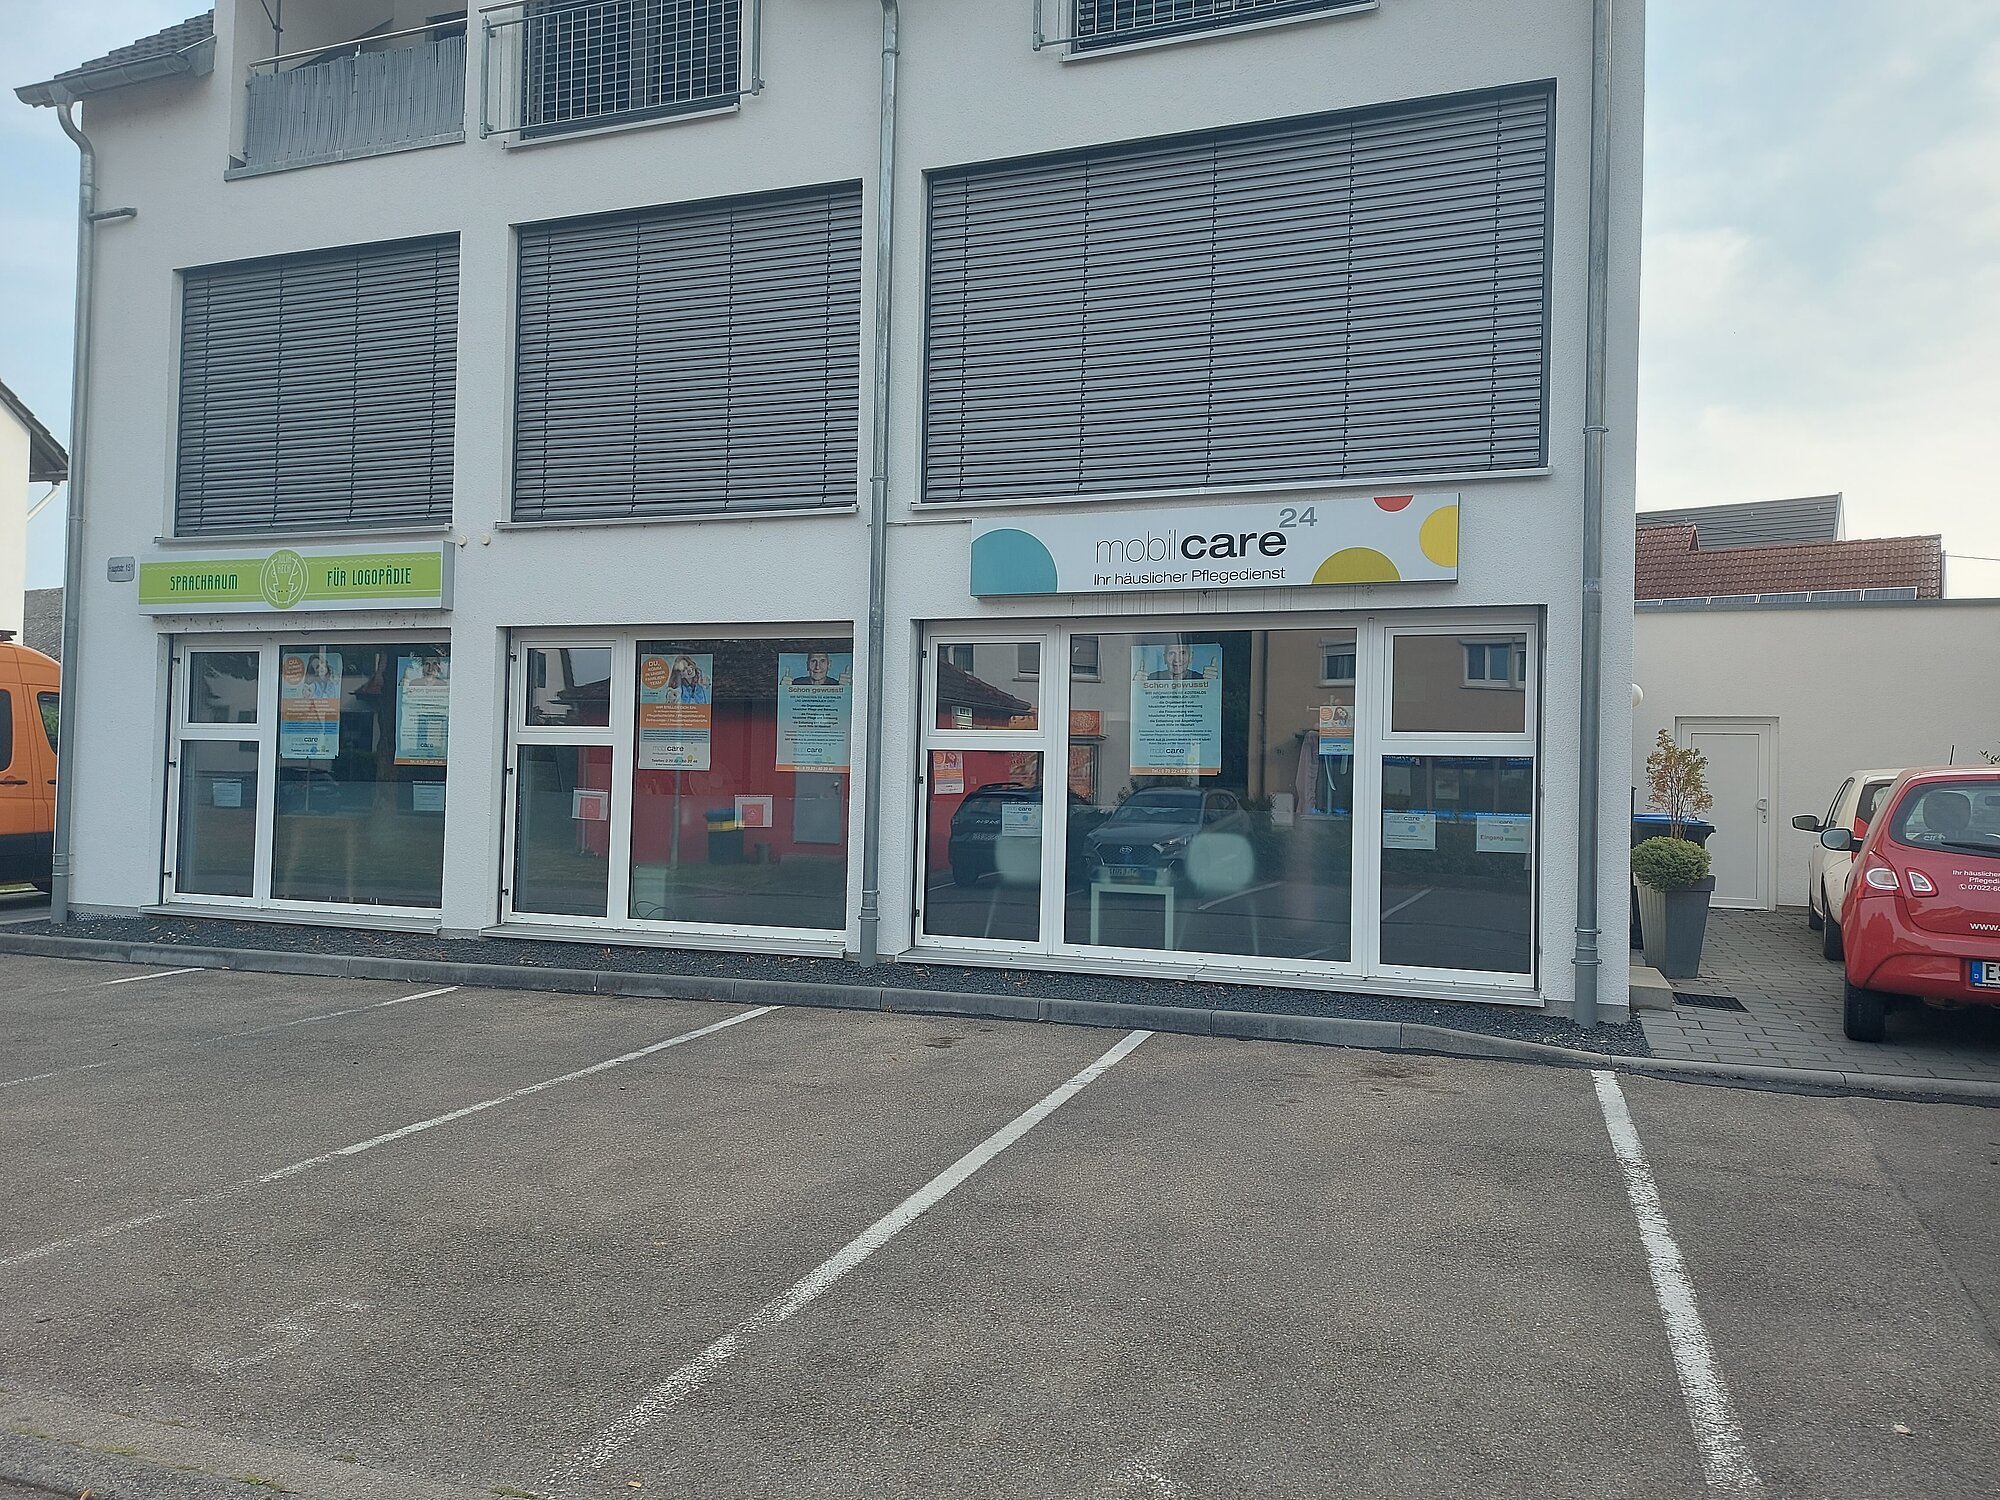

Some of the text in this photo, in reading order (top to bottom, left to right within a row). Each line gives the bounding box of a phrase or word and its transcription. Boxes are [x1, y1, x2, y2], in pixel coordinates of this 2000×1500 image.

[1278, 506, 1318, 529] 24
[170, 564, 412, 590] SPRACHRAUM FÜR LOGOPÄDIE
[1093, 567, 1286, 586] Ihr häuslicher Pflegedienst
[1986, 964, 2000, 981] E
